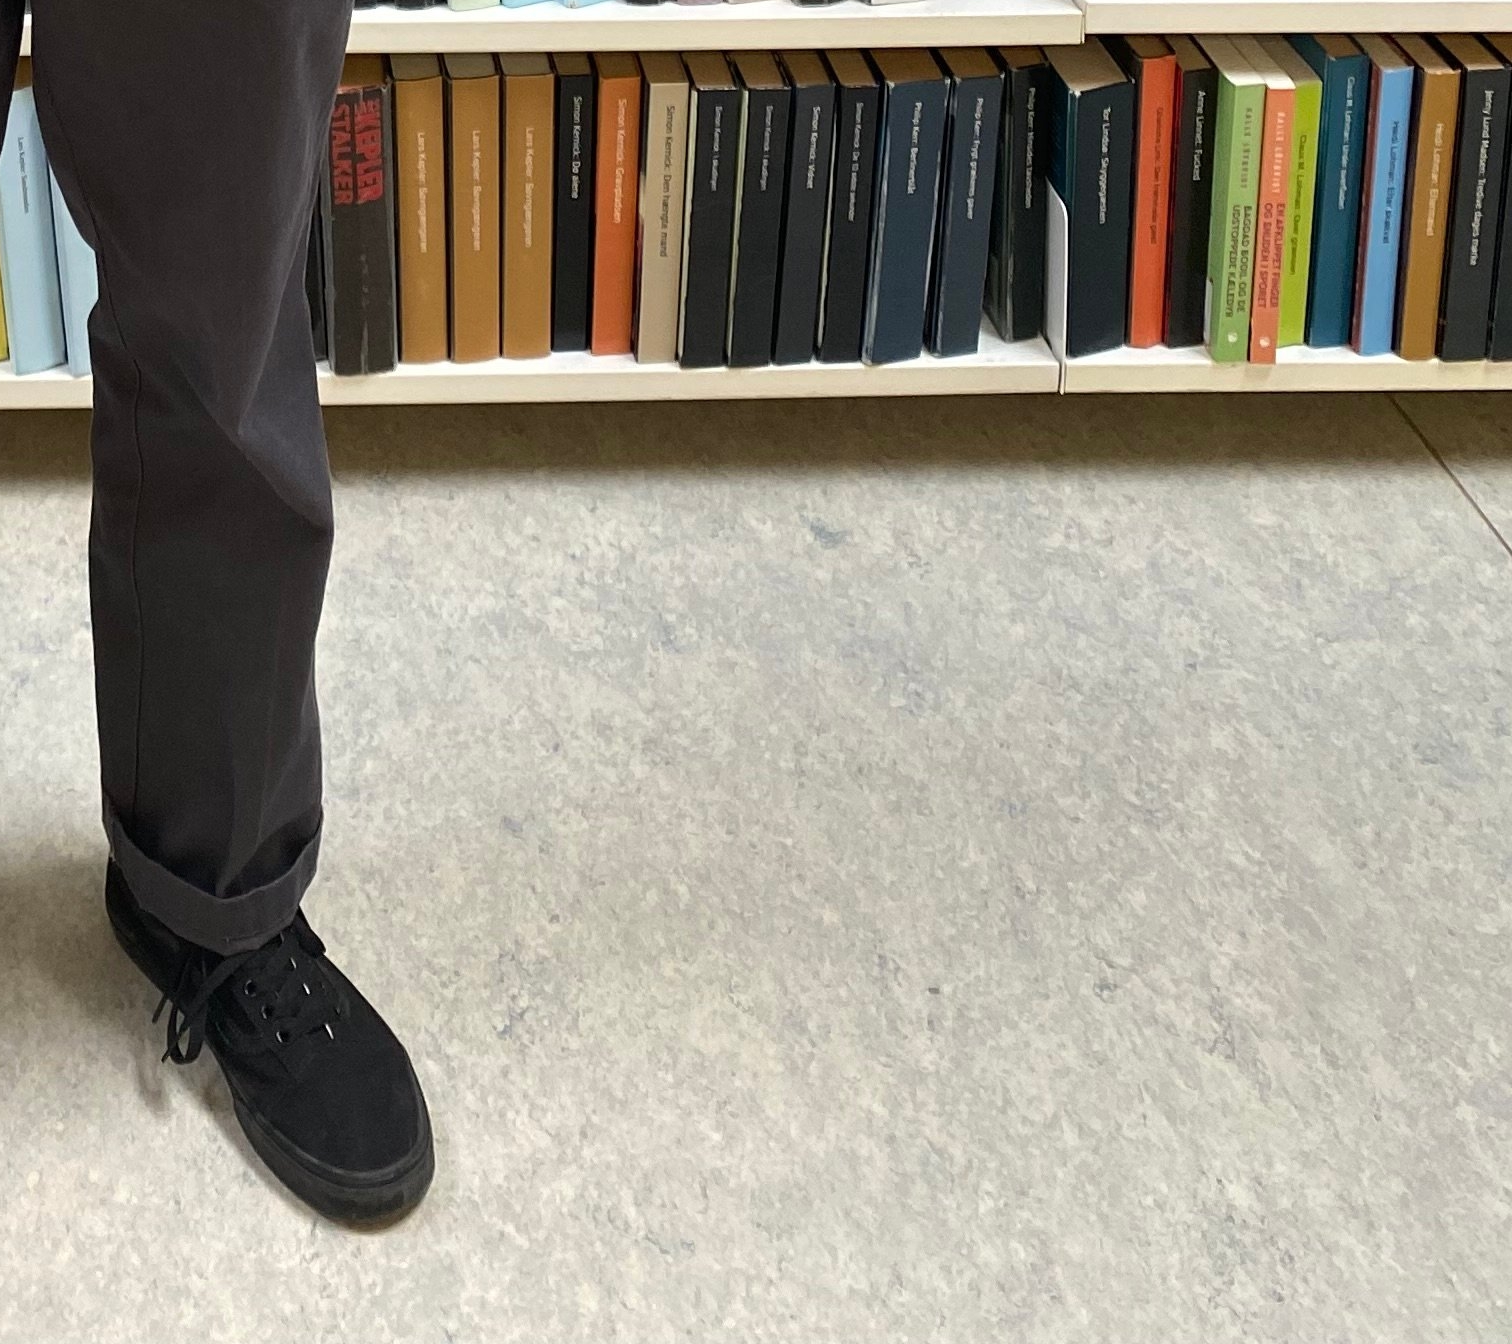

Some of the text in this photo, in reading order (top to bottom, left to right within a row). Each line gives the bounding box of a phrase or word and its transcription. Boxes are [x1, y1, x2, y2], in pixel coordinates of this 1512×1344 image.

[1195, 90, 1205, 114] Anne
[331, 103, 353, 205] STALKER
[354, 116, 384, 205] KEPLER
